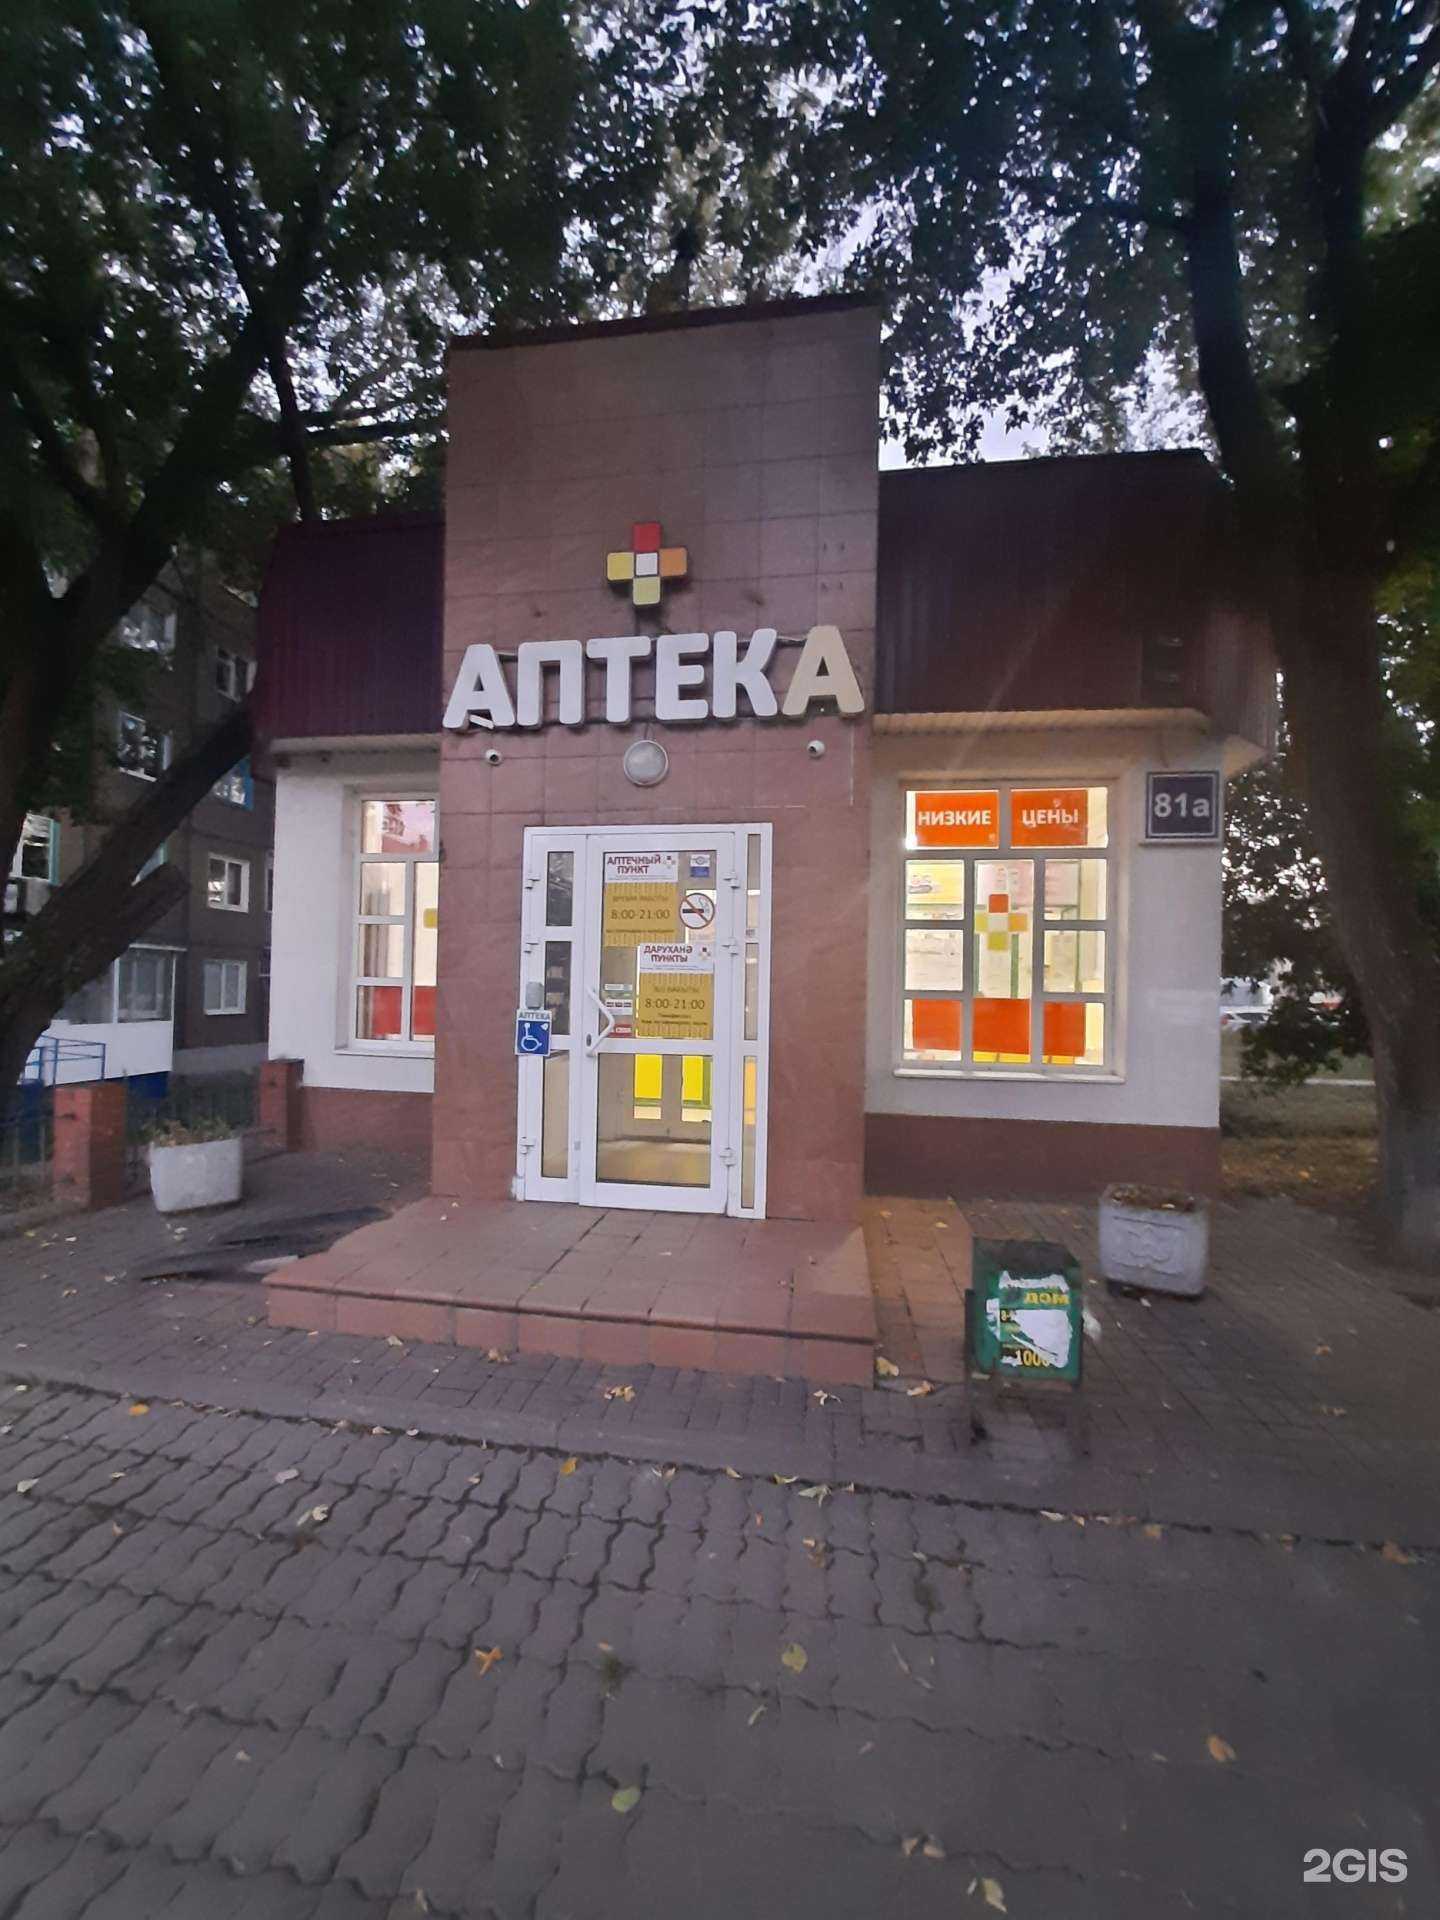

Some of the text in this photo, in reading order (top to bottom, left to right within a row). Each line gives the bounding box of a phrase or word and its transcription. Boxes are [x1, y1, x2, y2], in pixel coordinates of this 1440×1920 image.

[442, 625, 866, 730] АПТЕКА
[1154, 793, 1210, 818] 81а
[917, 810, 991, 826] НИЗКИЕ
[1021, 806, 1079, 828] ЦЕНЫ
[607, 854, 661, 865] АПТЕЧНЫЙ
[617, 866, 649, 874] ПУНКТ
[651, 954, 688, 962] ПУНКТЫ
[518, 1011, 550, 1020] АПТЕКА
